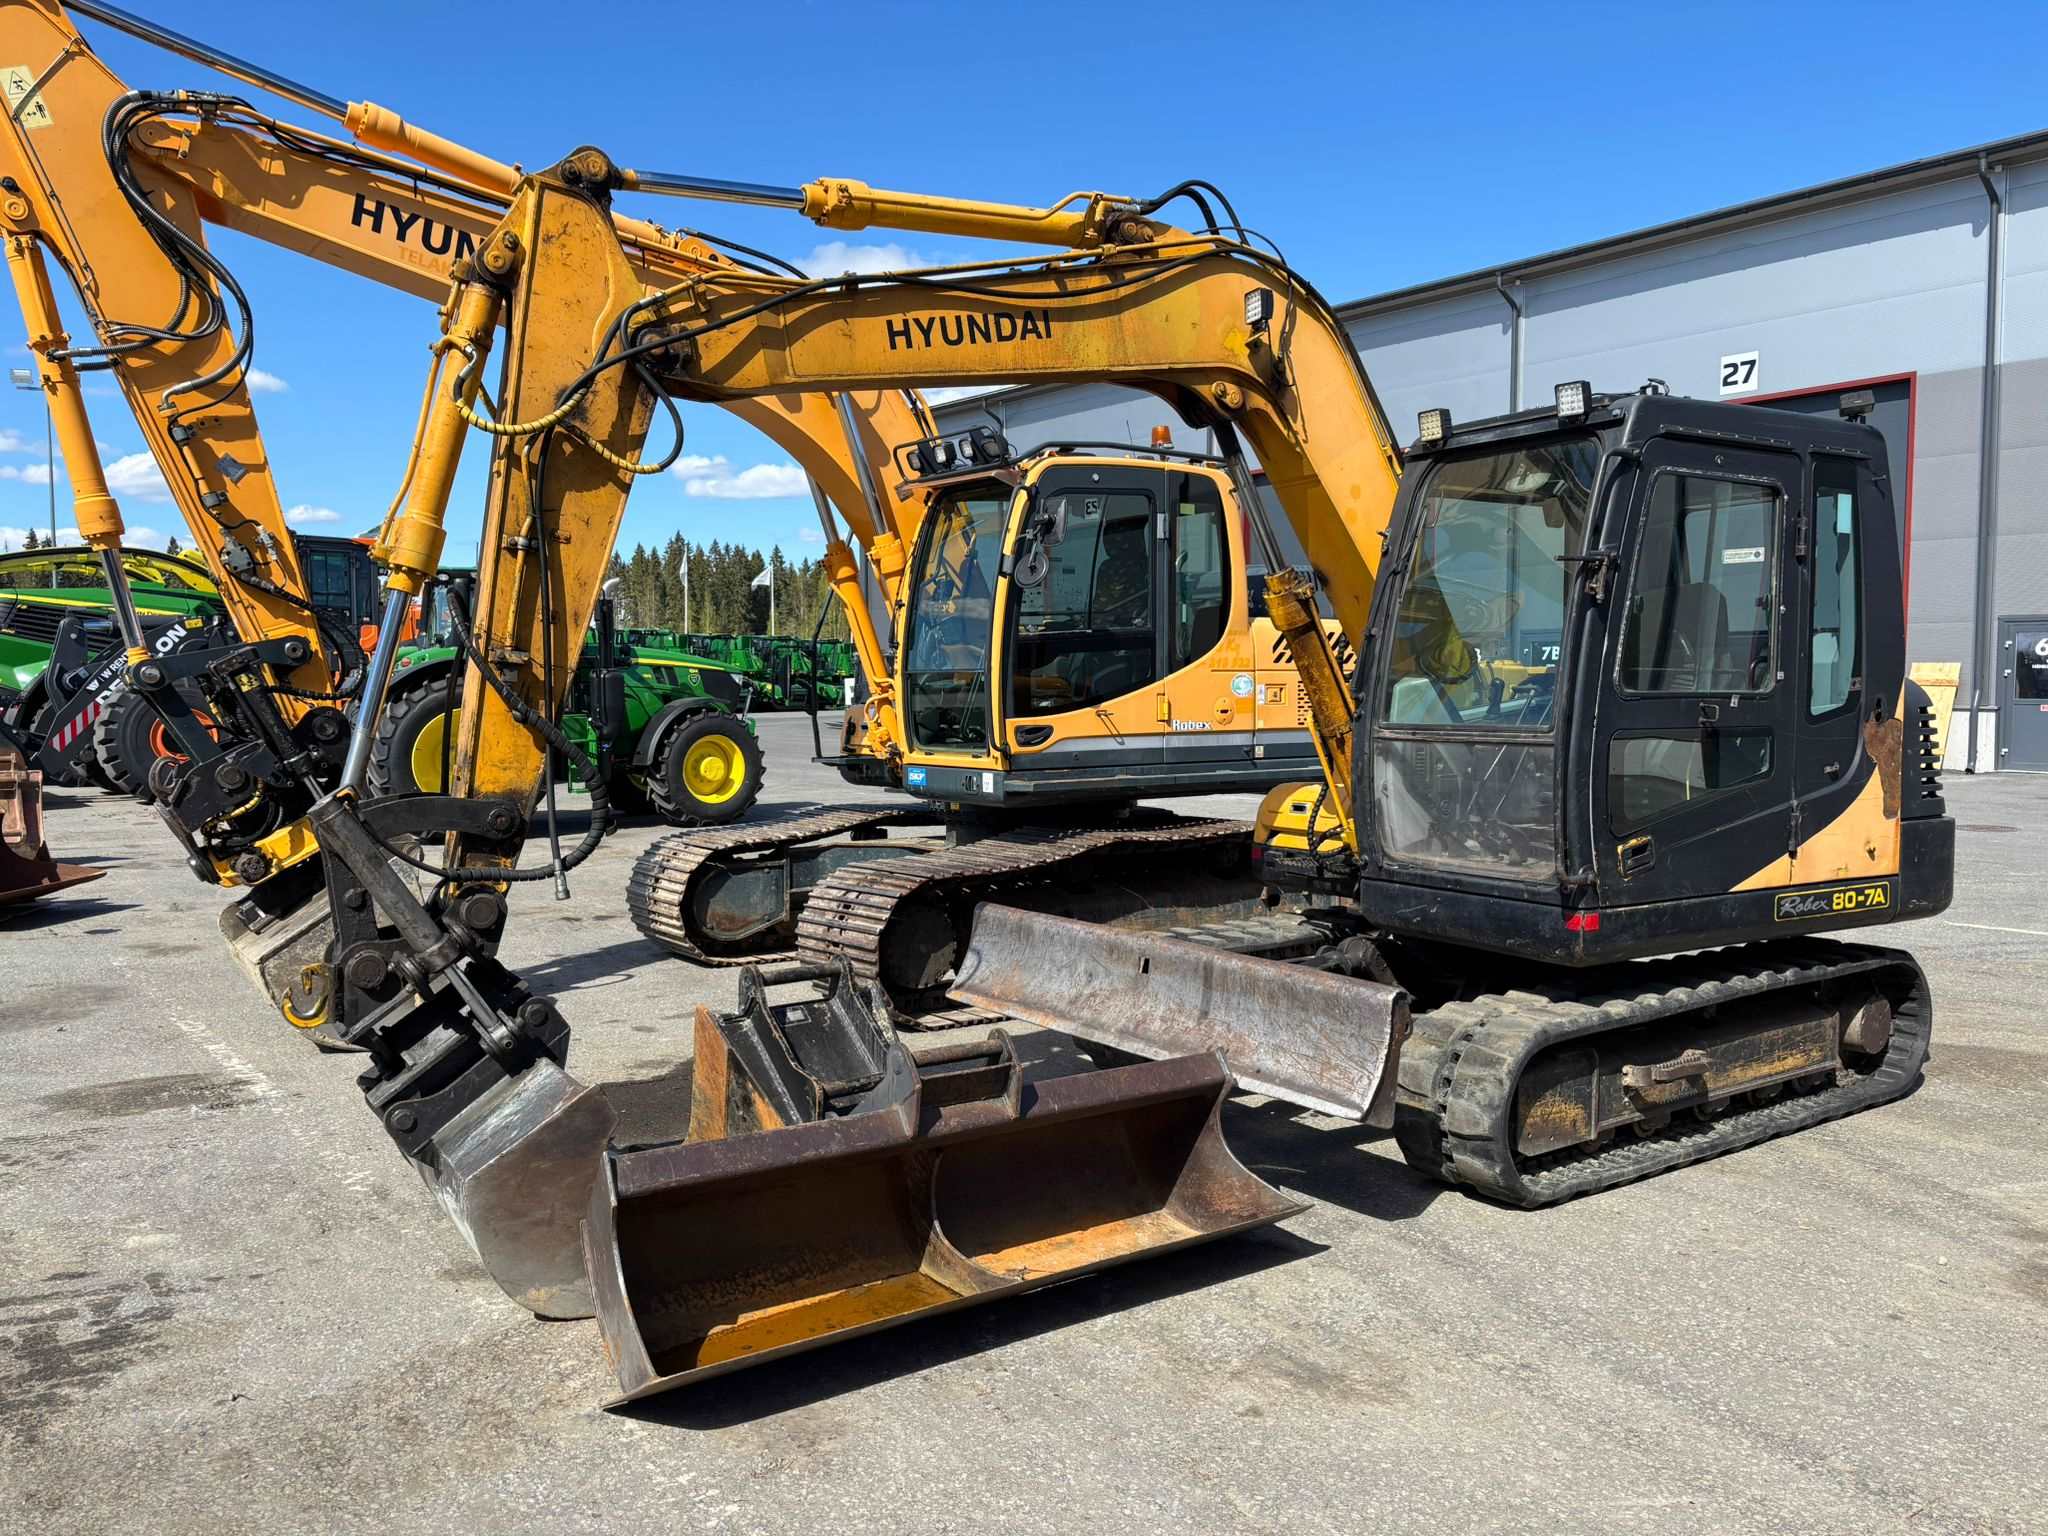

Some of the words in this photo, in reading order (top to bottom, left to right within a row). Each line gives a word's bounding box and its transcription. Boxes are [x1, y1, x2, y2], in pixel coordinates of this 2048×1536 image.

[886, 310, 1052, 350] HYUNDAI
[1722, 359, 1757, 387] 27
[1172, 719, 1212, 731] Robex
[1780, 895, 1830, 916] Robex
[1832, 888, 1886, 910] 80-7A
